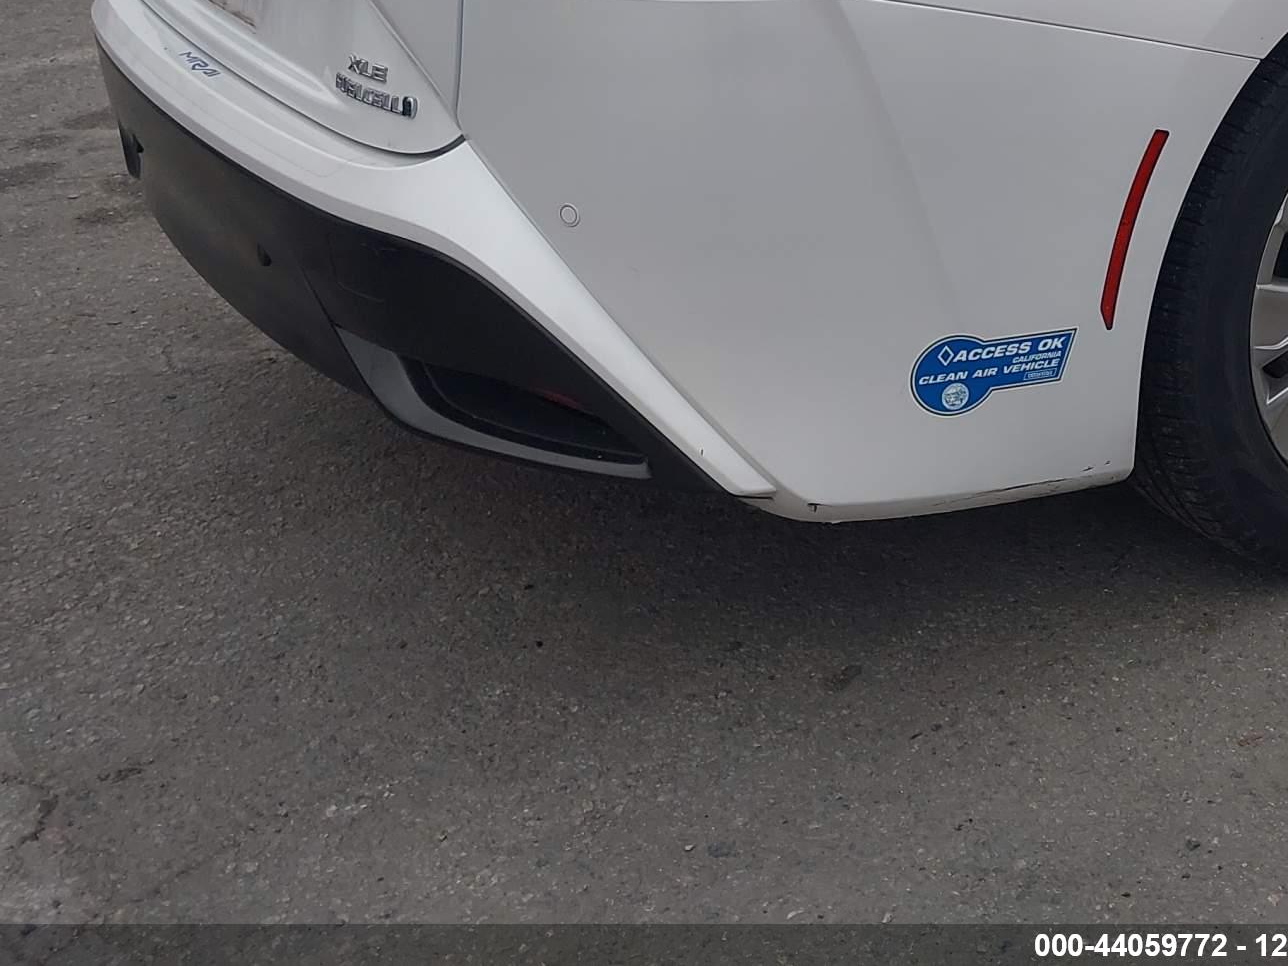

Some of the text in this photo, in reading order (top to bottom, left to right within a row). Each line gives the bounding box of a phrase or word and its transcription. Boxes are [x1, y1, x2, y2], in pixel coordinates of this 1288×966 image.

[348, 54, 388, 84] XLE
[953, 336, 1067, 363] ACCESS OK
[1012, 351, 1062, 364] CALIFORNIA
[918, 358, 1060, 385] CLEAN AIR VEHICLE
